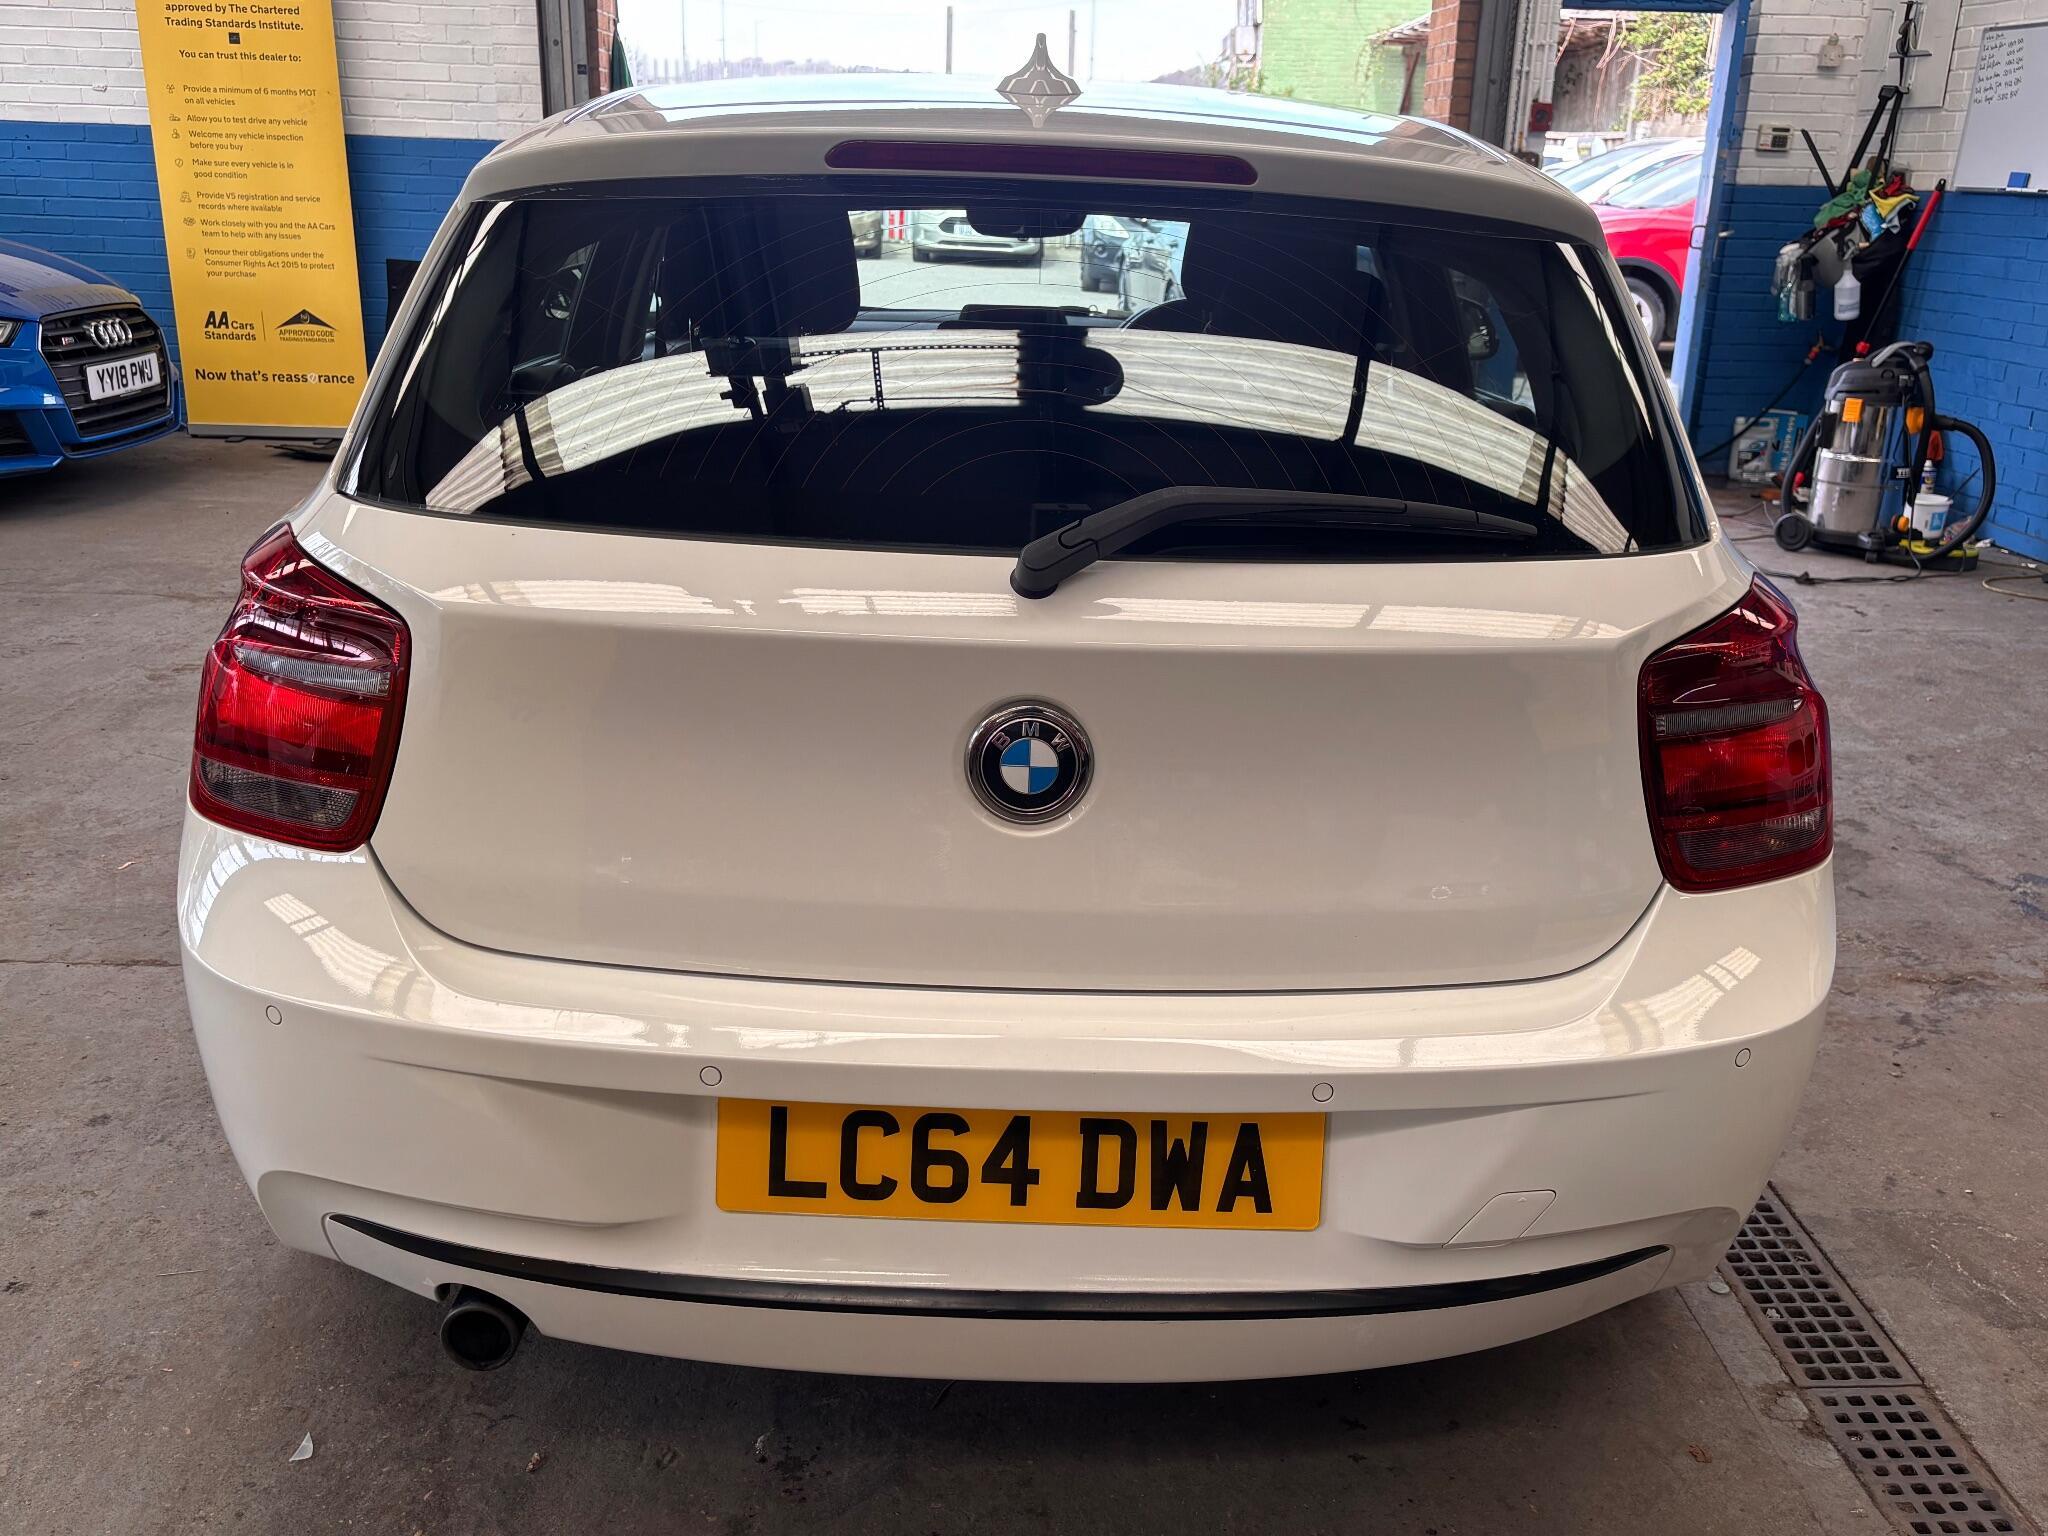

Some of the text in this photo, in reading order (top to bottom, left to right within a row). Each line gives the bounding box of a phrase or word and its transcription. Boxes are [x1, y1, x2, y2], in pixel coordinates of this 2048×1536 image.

[165, 3, 300, 15] approved by The Chartered
[164, 16, 304, 31] Trading Standards Institute.
[179, 49, 196, 58] You
[216, 51, 238, 60] trust
[240, 52, 257, 61] this
[259, 53, 287, 61] dealer
[288, 54, 302, 62] to:
[182, 84, 211, 93] Provide
[218, 86, 252, 94] minimum
[254, 86, 262, 95] of
[263, 87, 269, 95] 6
[270, 88, 298, 96] months
[299, 88, 316, 96] MOT
[195, 97, 204, 105] all
[205, 98, 236, 106] vehicles
[186, 114, 208, 122] Allow
[209, 116, 223, 124] you
[232, 116, 247, 124] test
[248, 117, 267, 125] drive
[282, 118, 308, 126] vehicle
[188, 130, 304, 143] Welcome any vehicle inspection
[190, 141, 243, 152] before you buy
[192, 158, 213, 167] Make
[230, 161, 250, 169] every
[251, 160, 278, 169] vehicle
[279, 161, 286, 169] is
[193, 171, 248, 179] good condition
[196, 191, 321, 202] Provide V5 registration and service
[198, 202, 226, 210] records
[250, 204, 282, 212] available
[200, 218, 220, 227] Work
[221, 219, 246, 228] closely
[247, 220, 263, 228] with
[279, 221, 293, 229] and
[294, 221, 306, 229] the
[307, 222, 318, 230] AA
[318, 222, 336, 230] Cars
[201, 230, 220, 238] team
[230, 231, 246, 240] help
[247, 231, 263, 239] with
[203, 248, 324, 259] Honour their obligations under the
[205, 258, 242, 267] Consumer
[243, 260, 266, 269] Rights
[267, 260, 280, 268] Act
[281, 261, 300, 269] 2015
[309, 262, 335, 271] protect
[224, 270, 257, 279] purchase
[204, 310, 255, 330] AA Cars
[204, 330, 257, 341] Standards
[279, 329, 335, 338] APPROVED CODE
[96, 358, 153, 393] YY18 PWU
[195, 368, 227, 381] Now
[230, 370, 269, 382] that's
[991, 721, 1071, 752] BMW
[768, 1105, 1273, 1214] LC64 DWA
